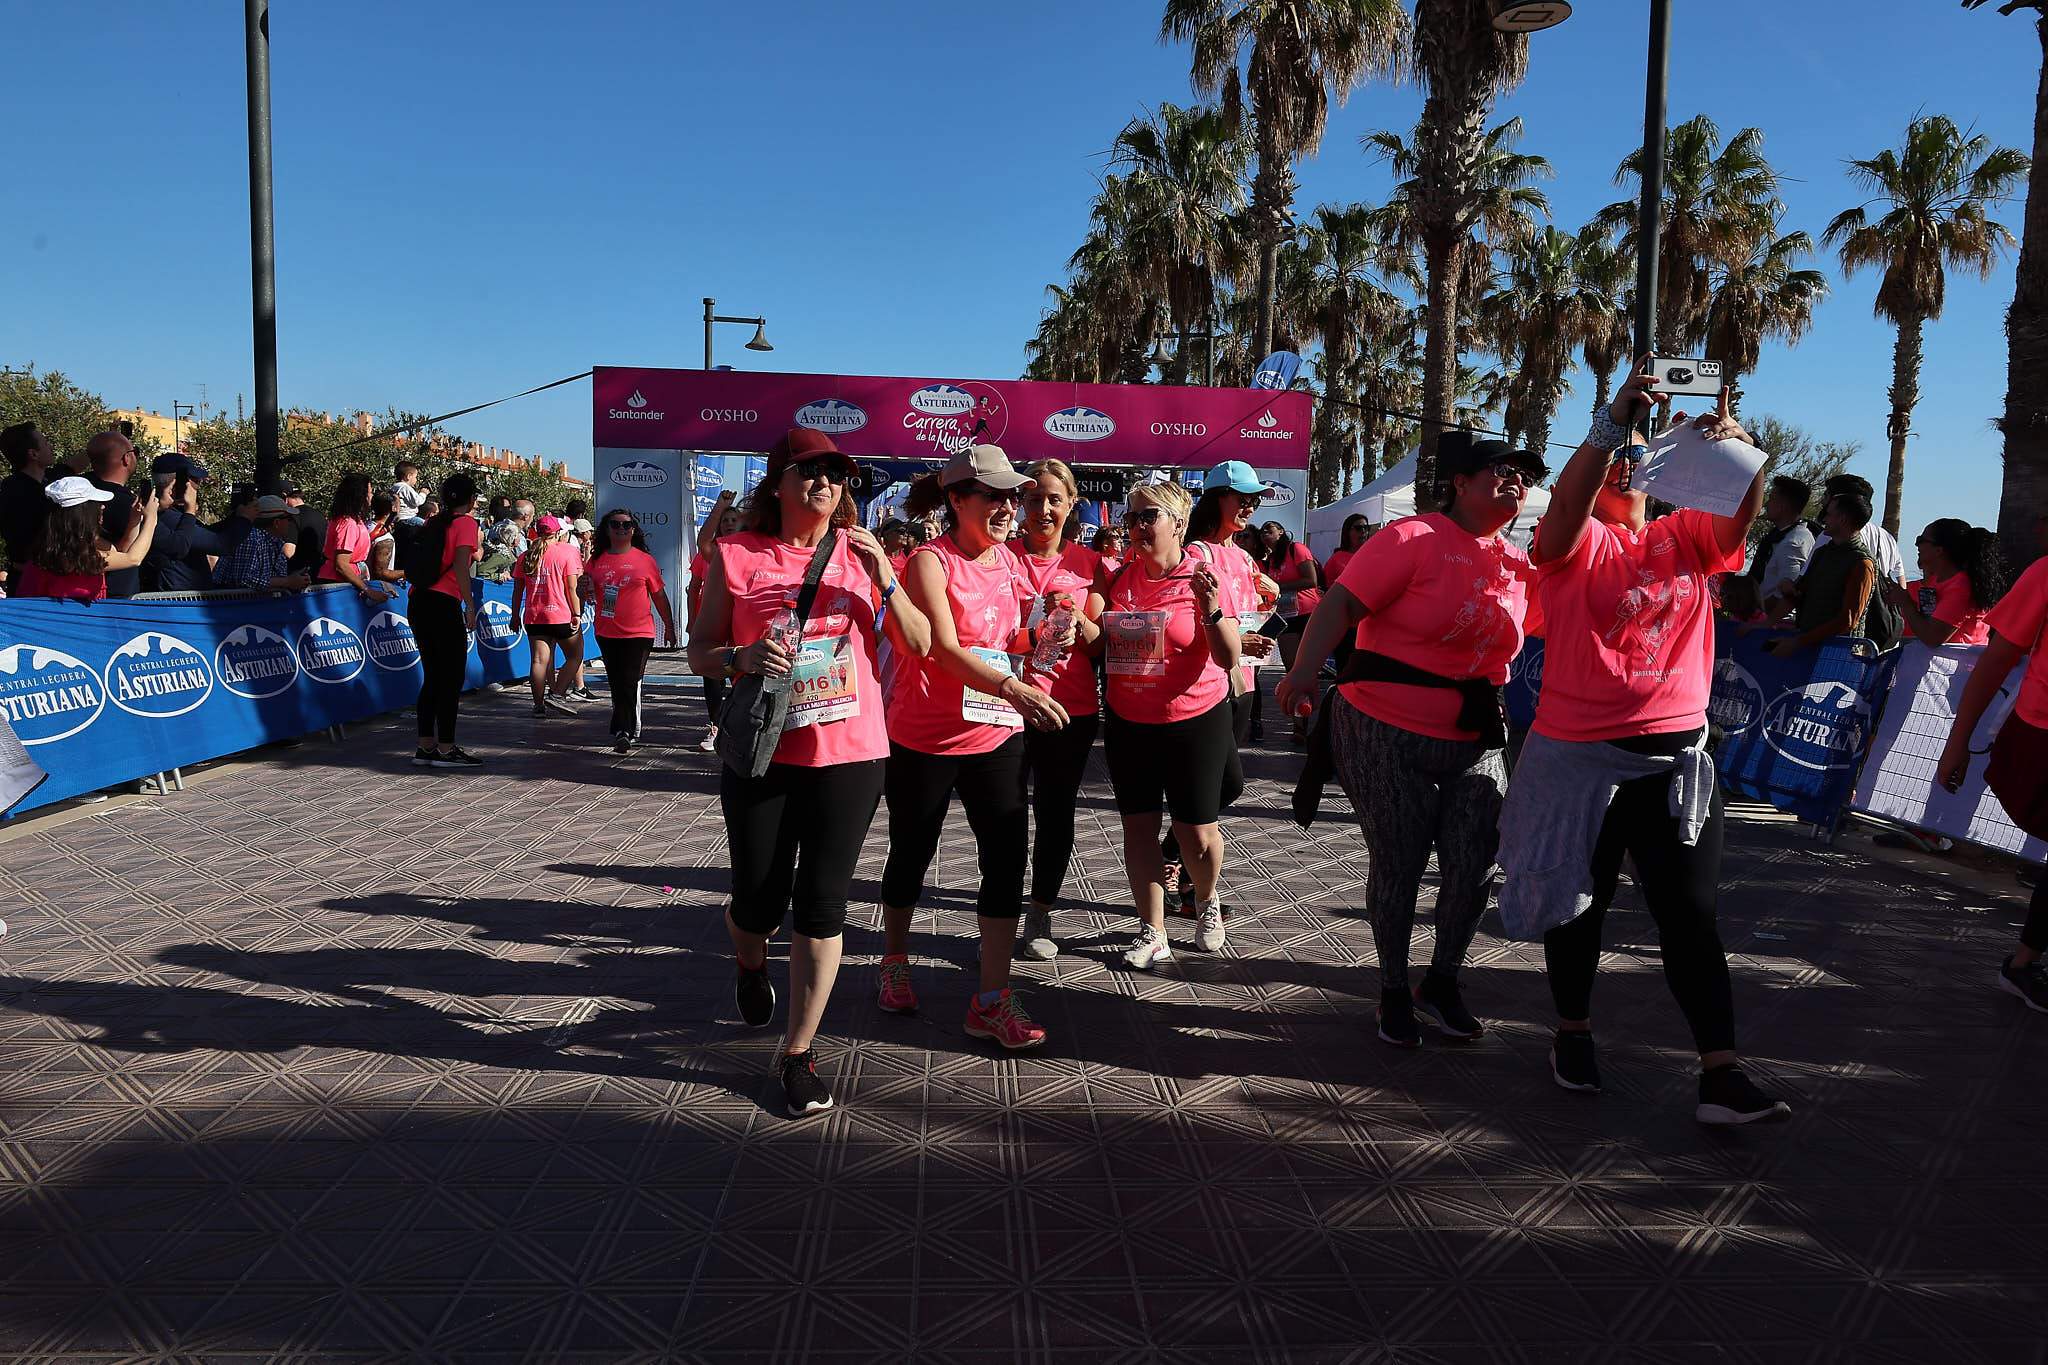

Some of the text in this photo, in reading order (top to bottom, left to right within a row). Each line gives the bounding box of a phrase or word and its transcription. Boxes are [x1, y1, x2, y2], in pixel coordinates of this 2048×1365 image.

[914, 394, 970, 409] ASTURIANA
[608, 408, 665, 420] Santander
[700, 408, 758, 423] OYSHO
[799, 410, 861, 425] ASTURIANA
[903, 412, 958, 430] Carrera
[1049, 418, 1110, 433] ASTURIANA
[1150, 422, 1207, 436] OYSHO
[916, 428, 978, 455] de la Mujer
[1240, 428, 1294, 440] Santander
[614, 470, 664, 482] ASTURIANA
[304, 643, 363, 670] ASTURIANA
[129, 656, 199, 673] CENTRAL LECHERA
[224, 653, 296, 684] ASTURIANA
[0, 671, 87, 692] ENTRAL LECHERA
[117, 666, 209, 702] ASTURIANA
